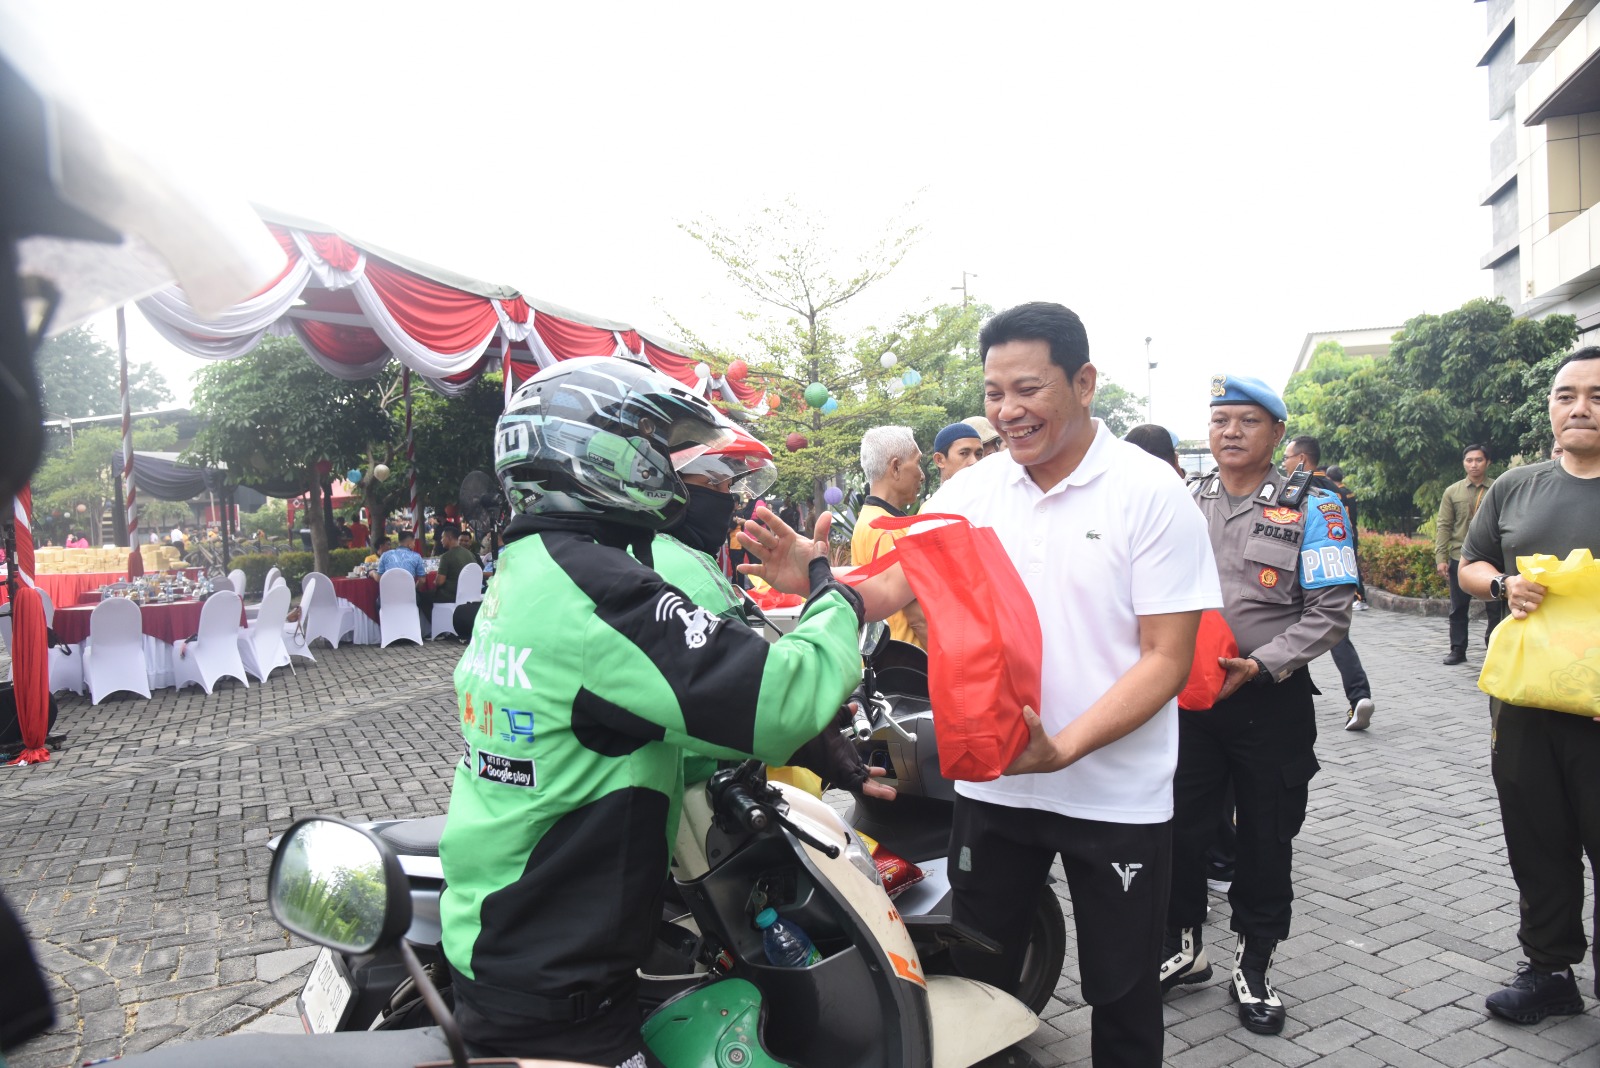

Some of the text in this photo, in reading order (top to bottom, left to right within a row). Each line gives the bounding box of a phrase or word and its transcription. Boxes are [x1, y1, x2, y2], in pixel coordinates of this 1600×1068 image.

[1253, 523, 1301, 544] POLRI
[487, 764, 531, 786] Google play
